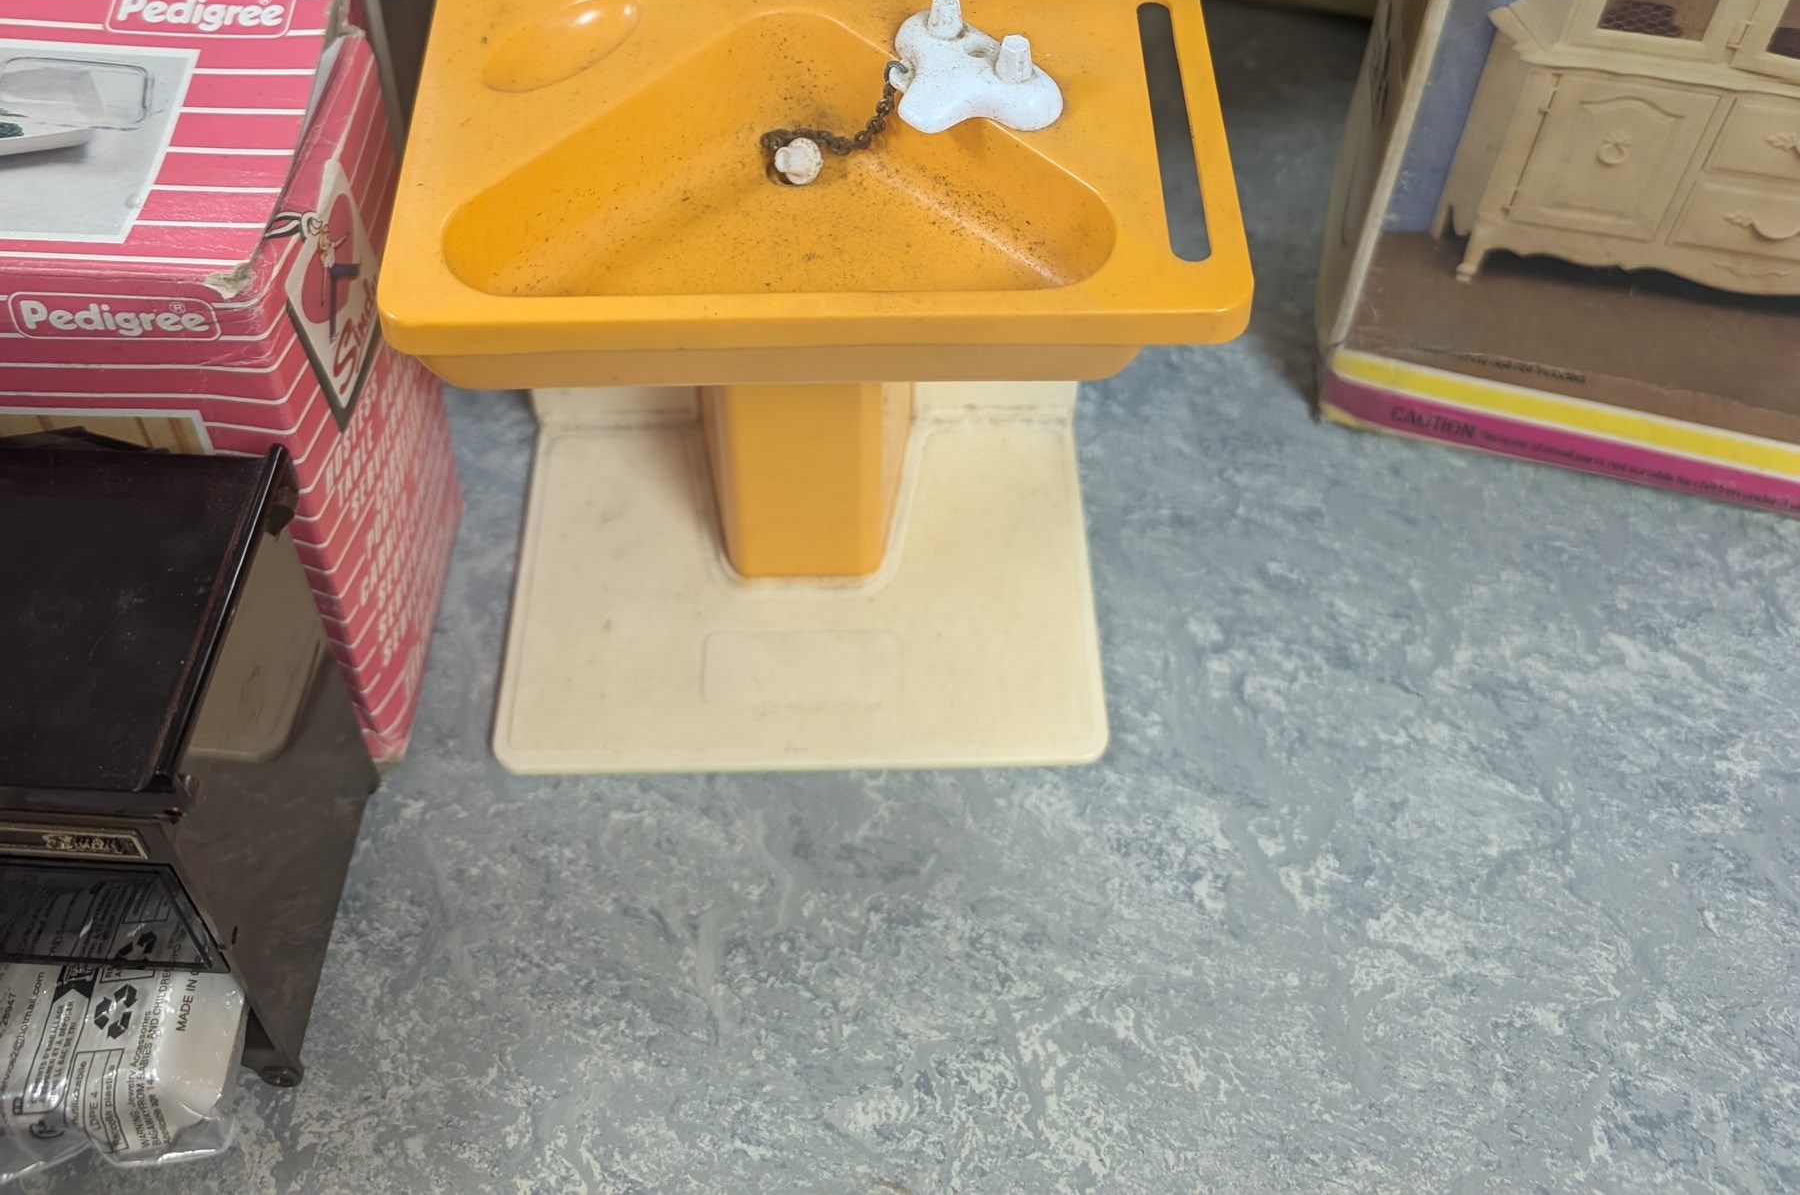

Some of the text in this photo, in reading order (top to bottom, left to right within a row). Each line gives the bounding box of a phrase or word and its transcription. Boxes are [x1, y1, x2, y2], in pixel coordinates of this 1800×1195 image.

[20, 299, 210, 336] Pedigree
[175, 994, 194, 1032] MADE
[186, 978, 198, 993] IN
[130, 1010, 152, 1067] Accessories
[147, 1016, 160, 1044] AND
[89, 1101, 102, 1131] LDPE
